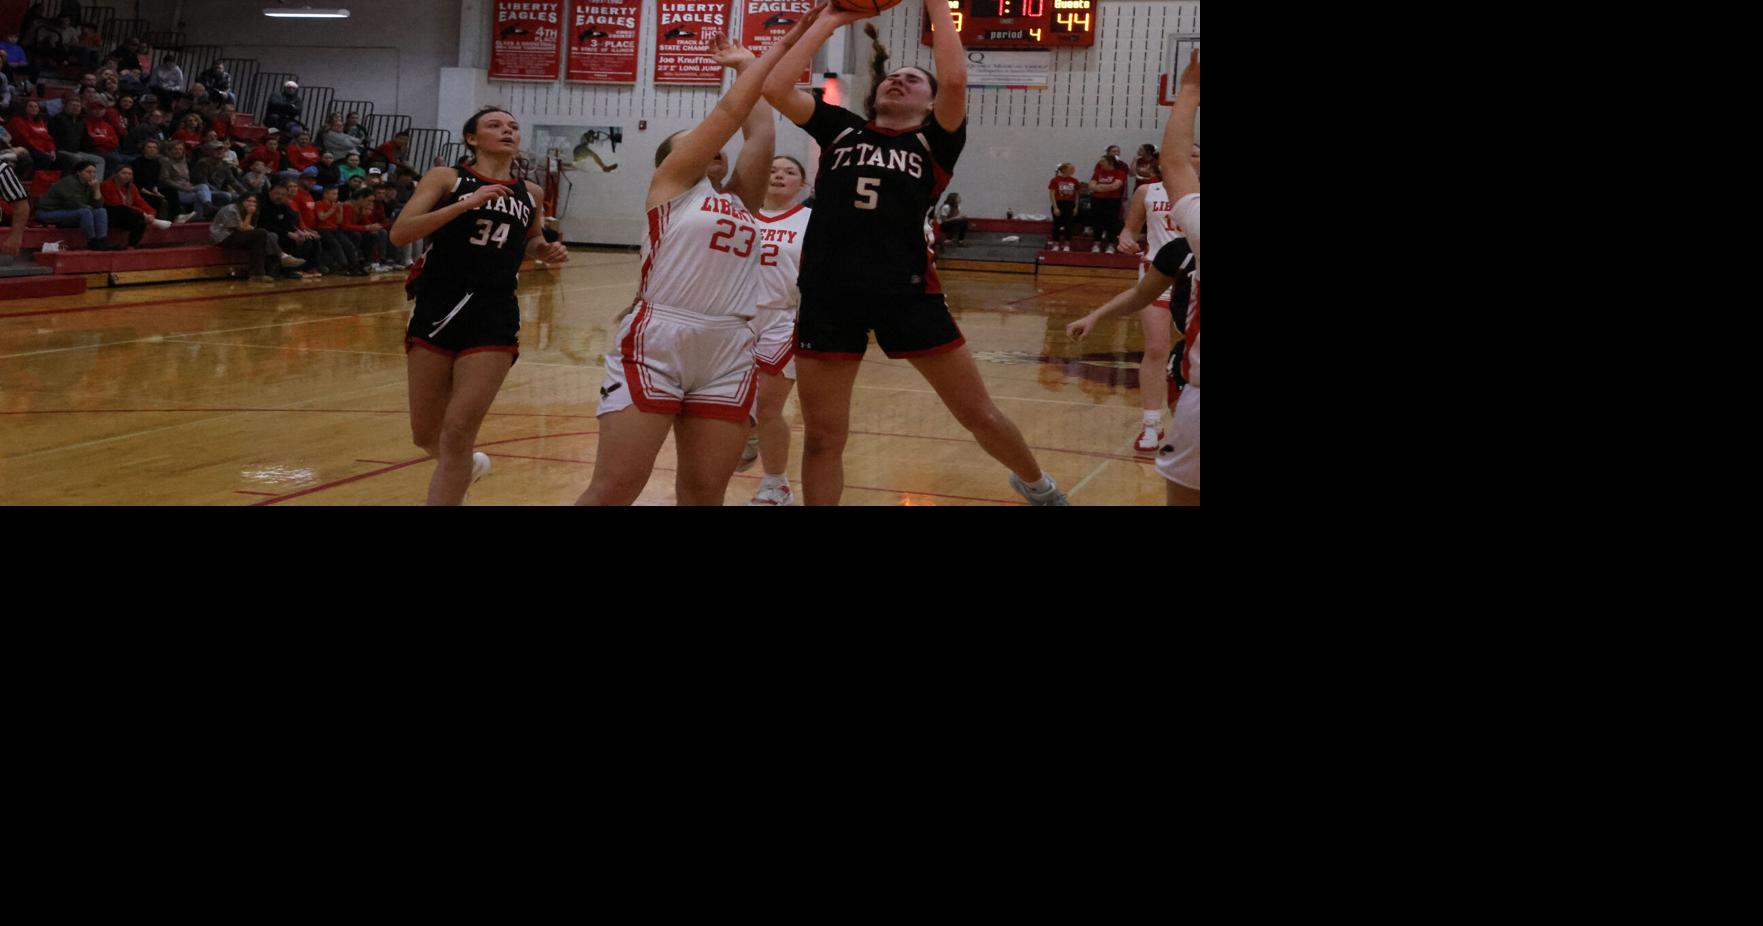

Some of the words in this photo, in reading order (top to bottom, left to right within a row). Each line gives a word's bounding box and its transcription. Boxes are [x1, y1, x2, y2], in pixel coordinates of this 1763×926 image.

[499, 2, 558, 11] LIBERTY
[576, 5, 637, 15] LIBERTY
[662, 3, 725, 12] LIBERTY
[748, 2, 812, 15] EAGLES
[499, 11, 558, 24] EAGLES
[576, 15, 636, 29] EAGLES
[661, 13, 724, 26] EAGLES
[1056, 12, 1091, 32] 44
[535, 26, 558, 40] 4TH
[990, 30, 1023, 40] period
[1029, 28, 1042, 42] 4
[659, 56, 675, 64] Joe
[967, 52, 985, 65] Q
[853, 176, 881, 210] 5
[468, 218, 511, 249] 34
[708, 217, 757, 259] 23
